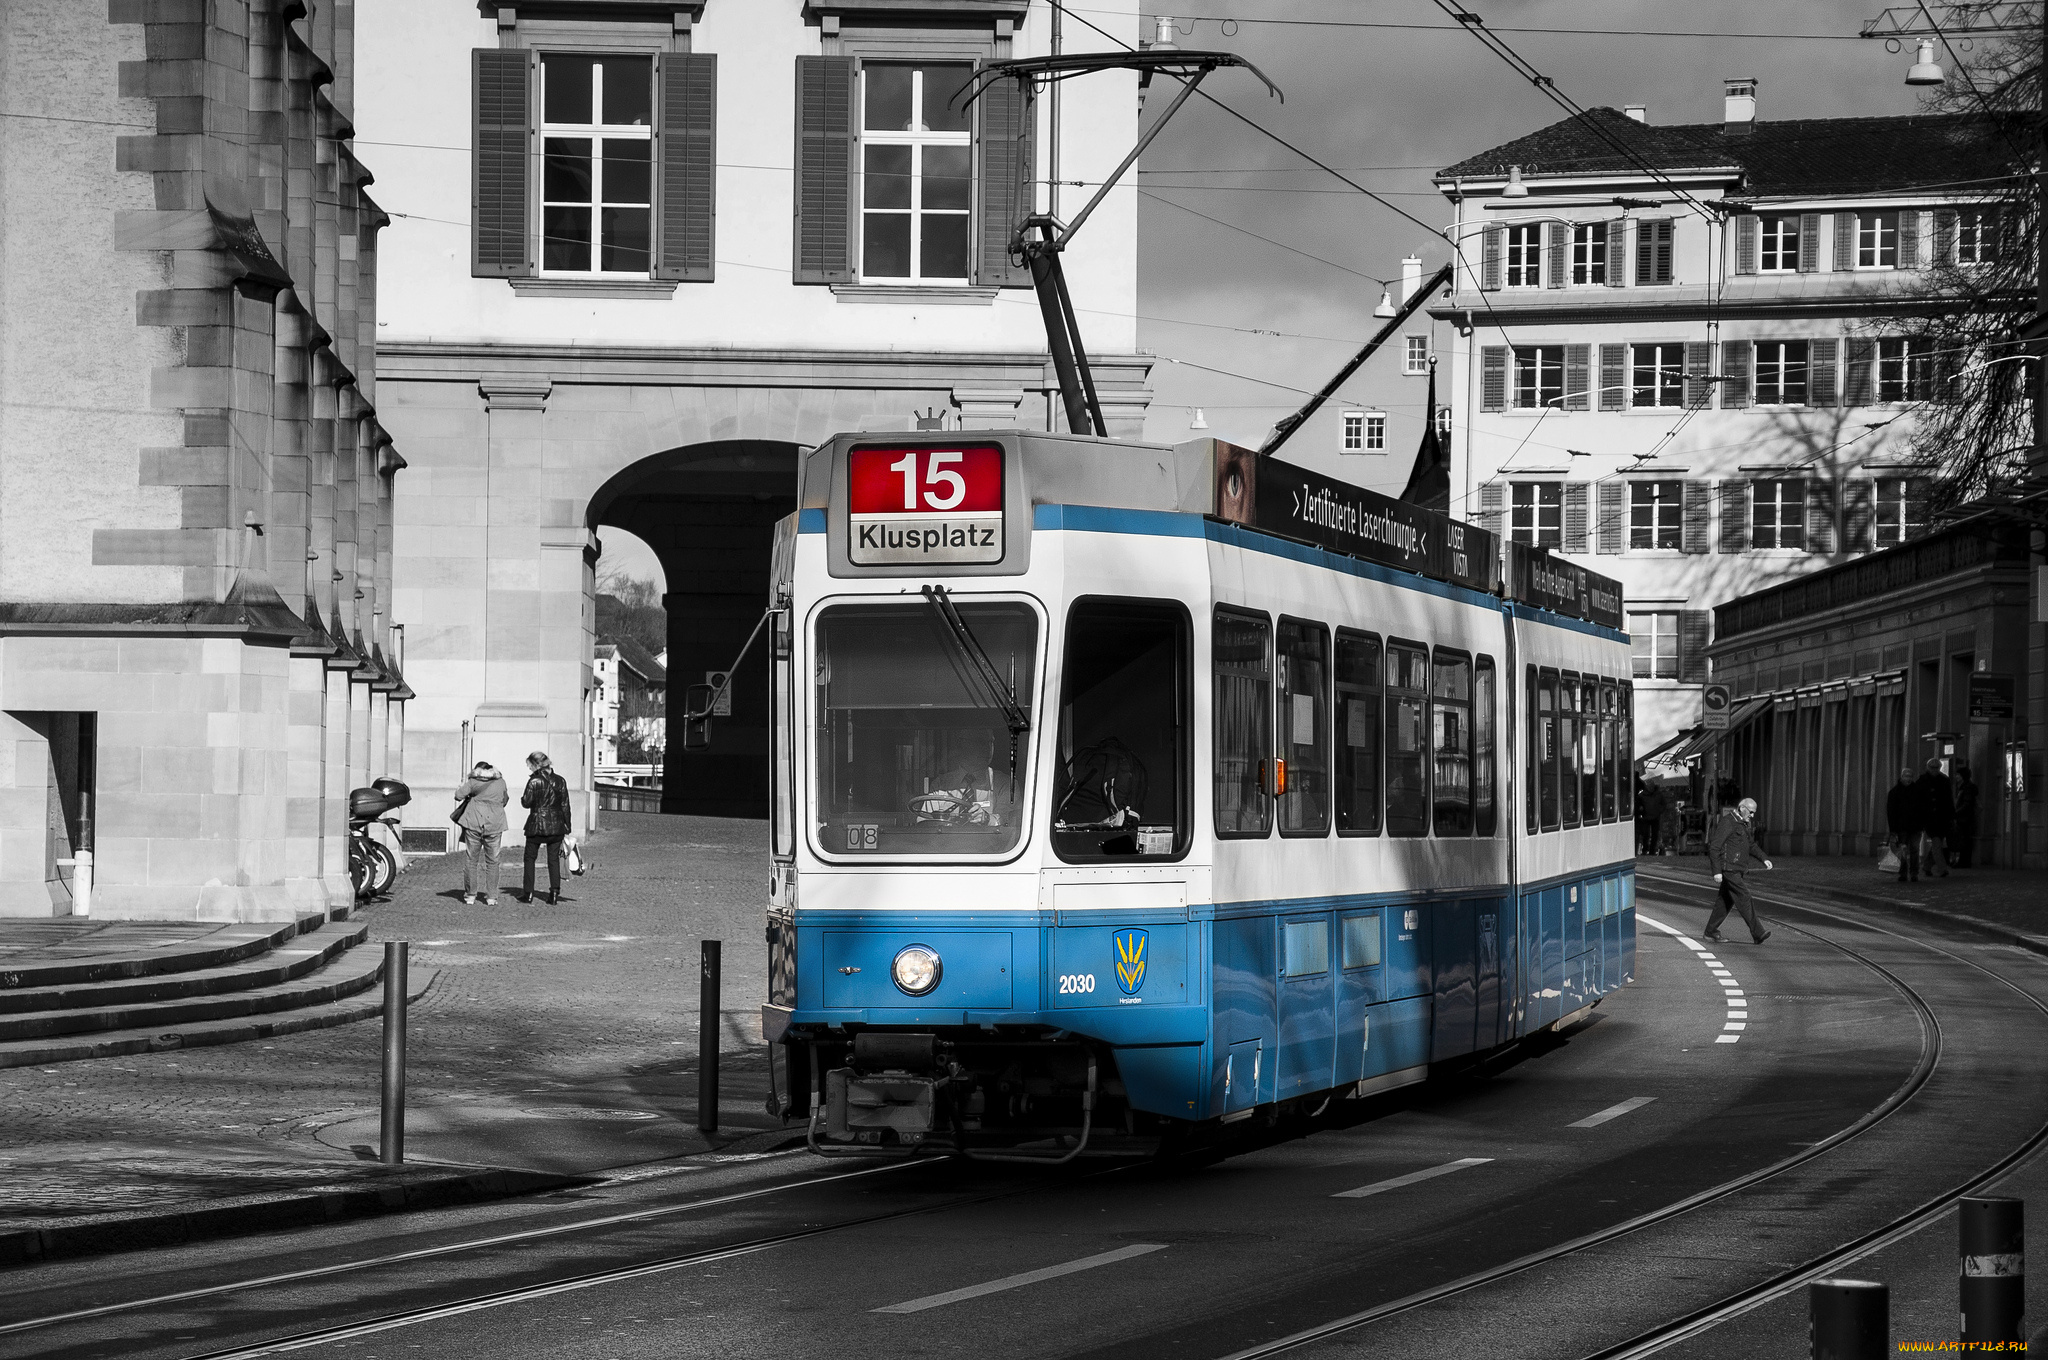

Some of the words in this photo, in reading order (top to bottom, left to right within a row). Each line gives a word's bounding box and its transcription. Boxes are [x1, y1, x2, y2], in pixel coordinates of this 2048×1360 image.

[890, 452, 966, 510] 15
[1303, 483, 1356, 535] Zertifizierte
[859, 523, 995, 553] Klusplatz
[1447, 523, 1465, 551] LASER
[1453, 551, 1469, 578] VISTA
[1973, 709, 1981, 717] 15
[850, 828, 876, 845] 08
[1059, 973, 1095, 994] 2030
